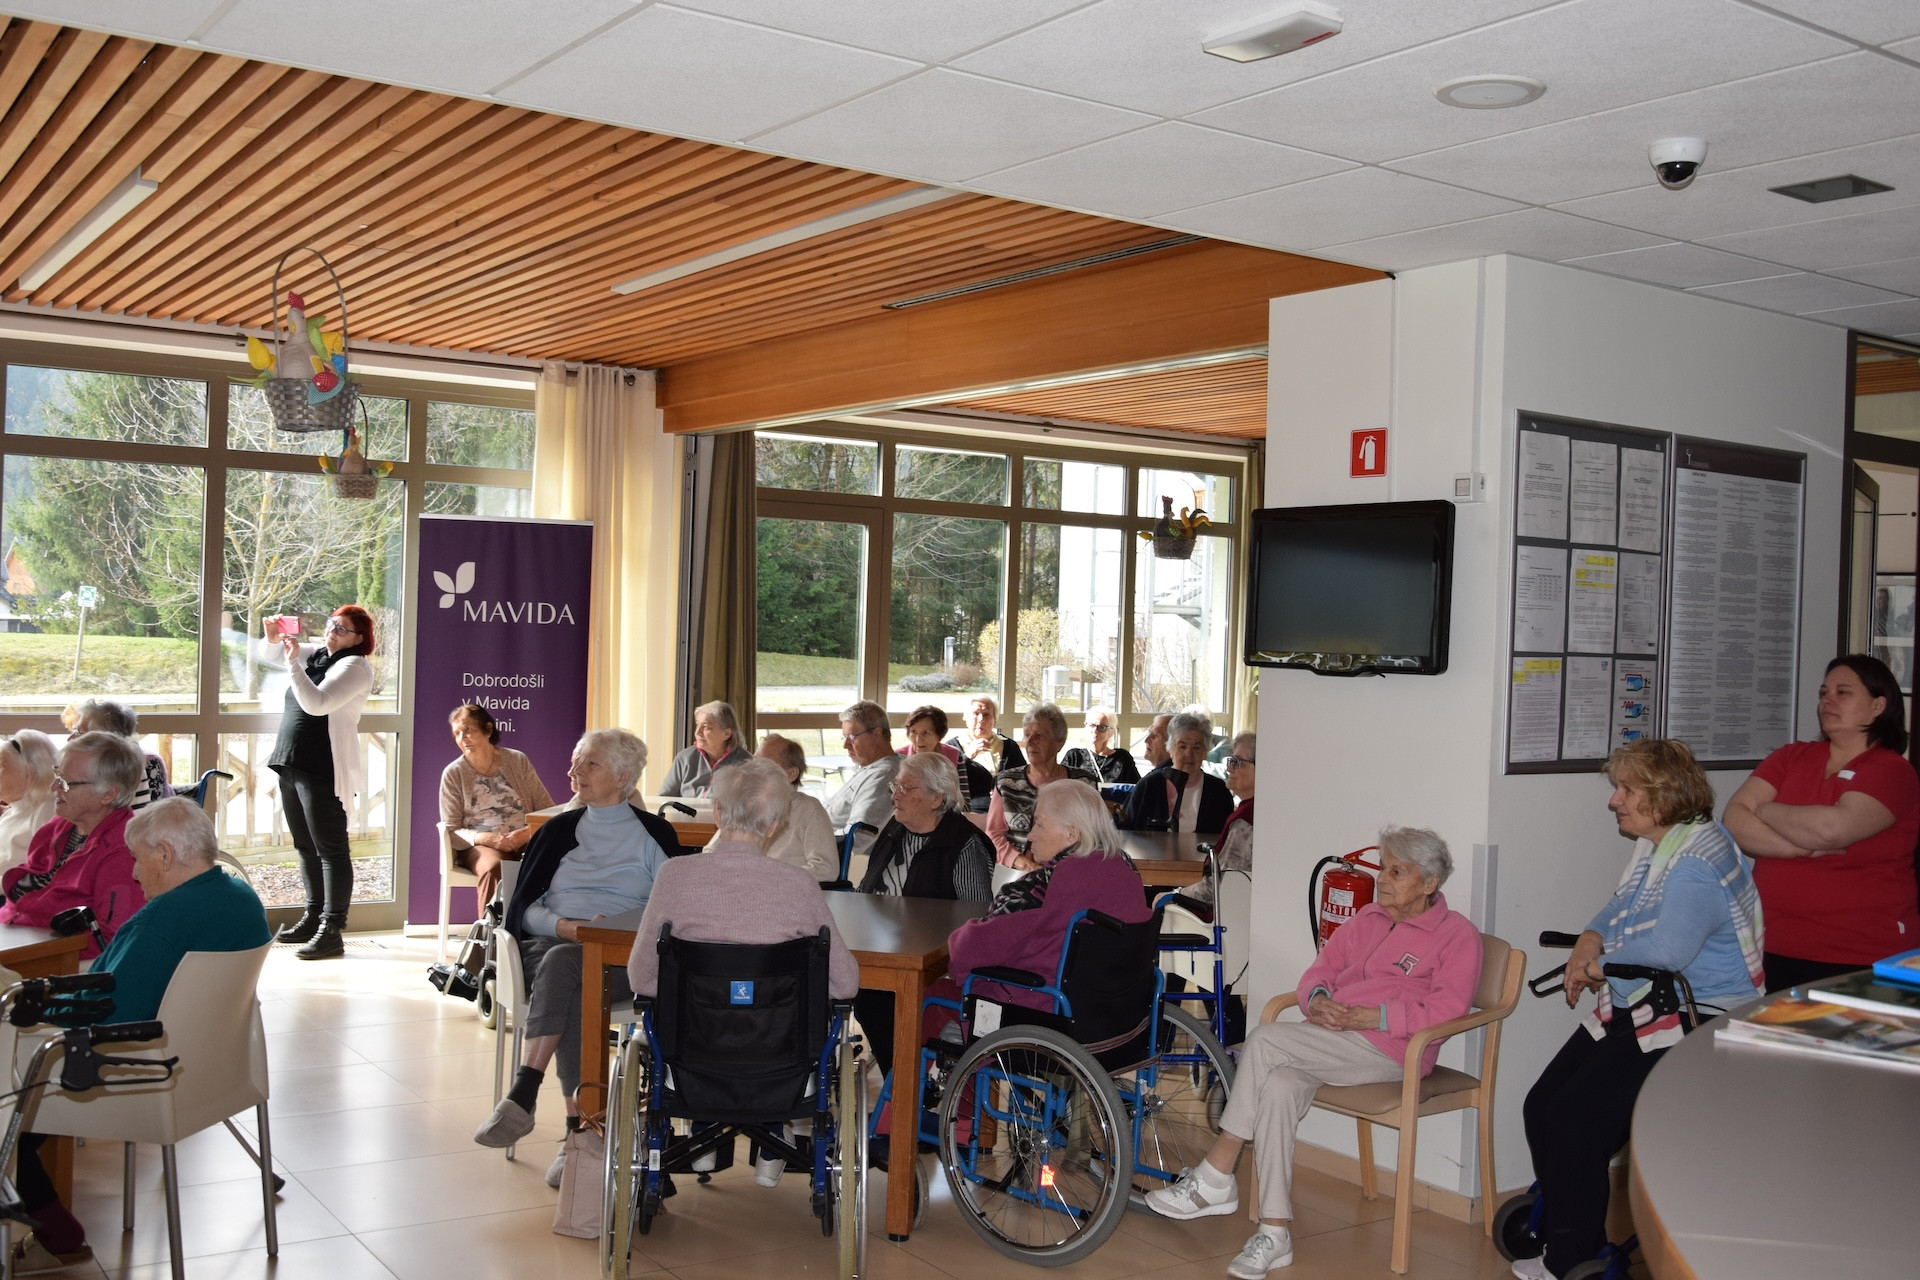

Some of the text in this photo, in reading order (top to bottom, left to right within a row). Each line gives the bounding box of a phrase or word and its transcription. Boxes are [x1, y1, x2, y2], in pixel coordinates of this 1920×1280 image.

[463, 600, 576, 625] MAVIDA
[462, 672, 545, 688] Dobrodošli
[475, 696, 530, 710] Mavida
[1323, 902, 1357, 917] PASTOR
